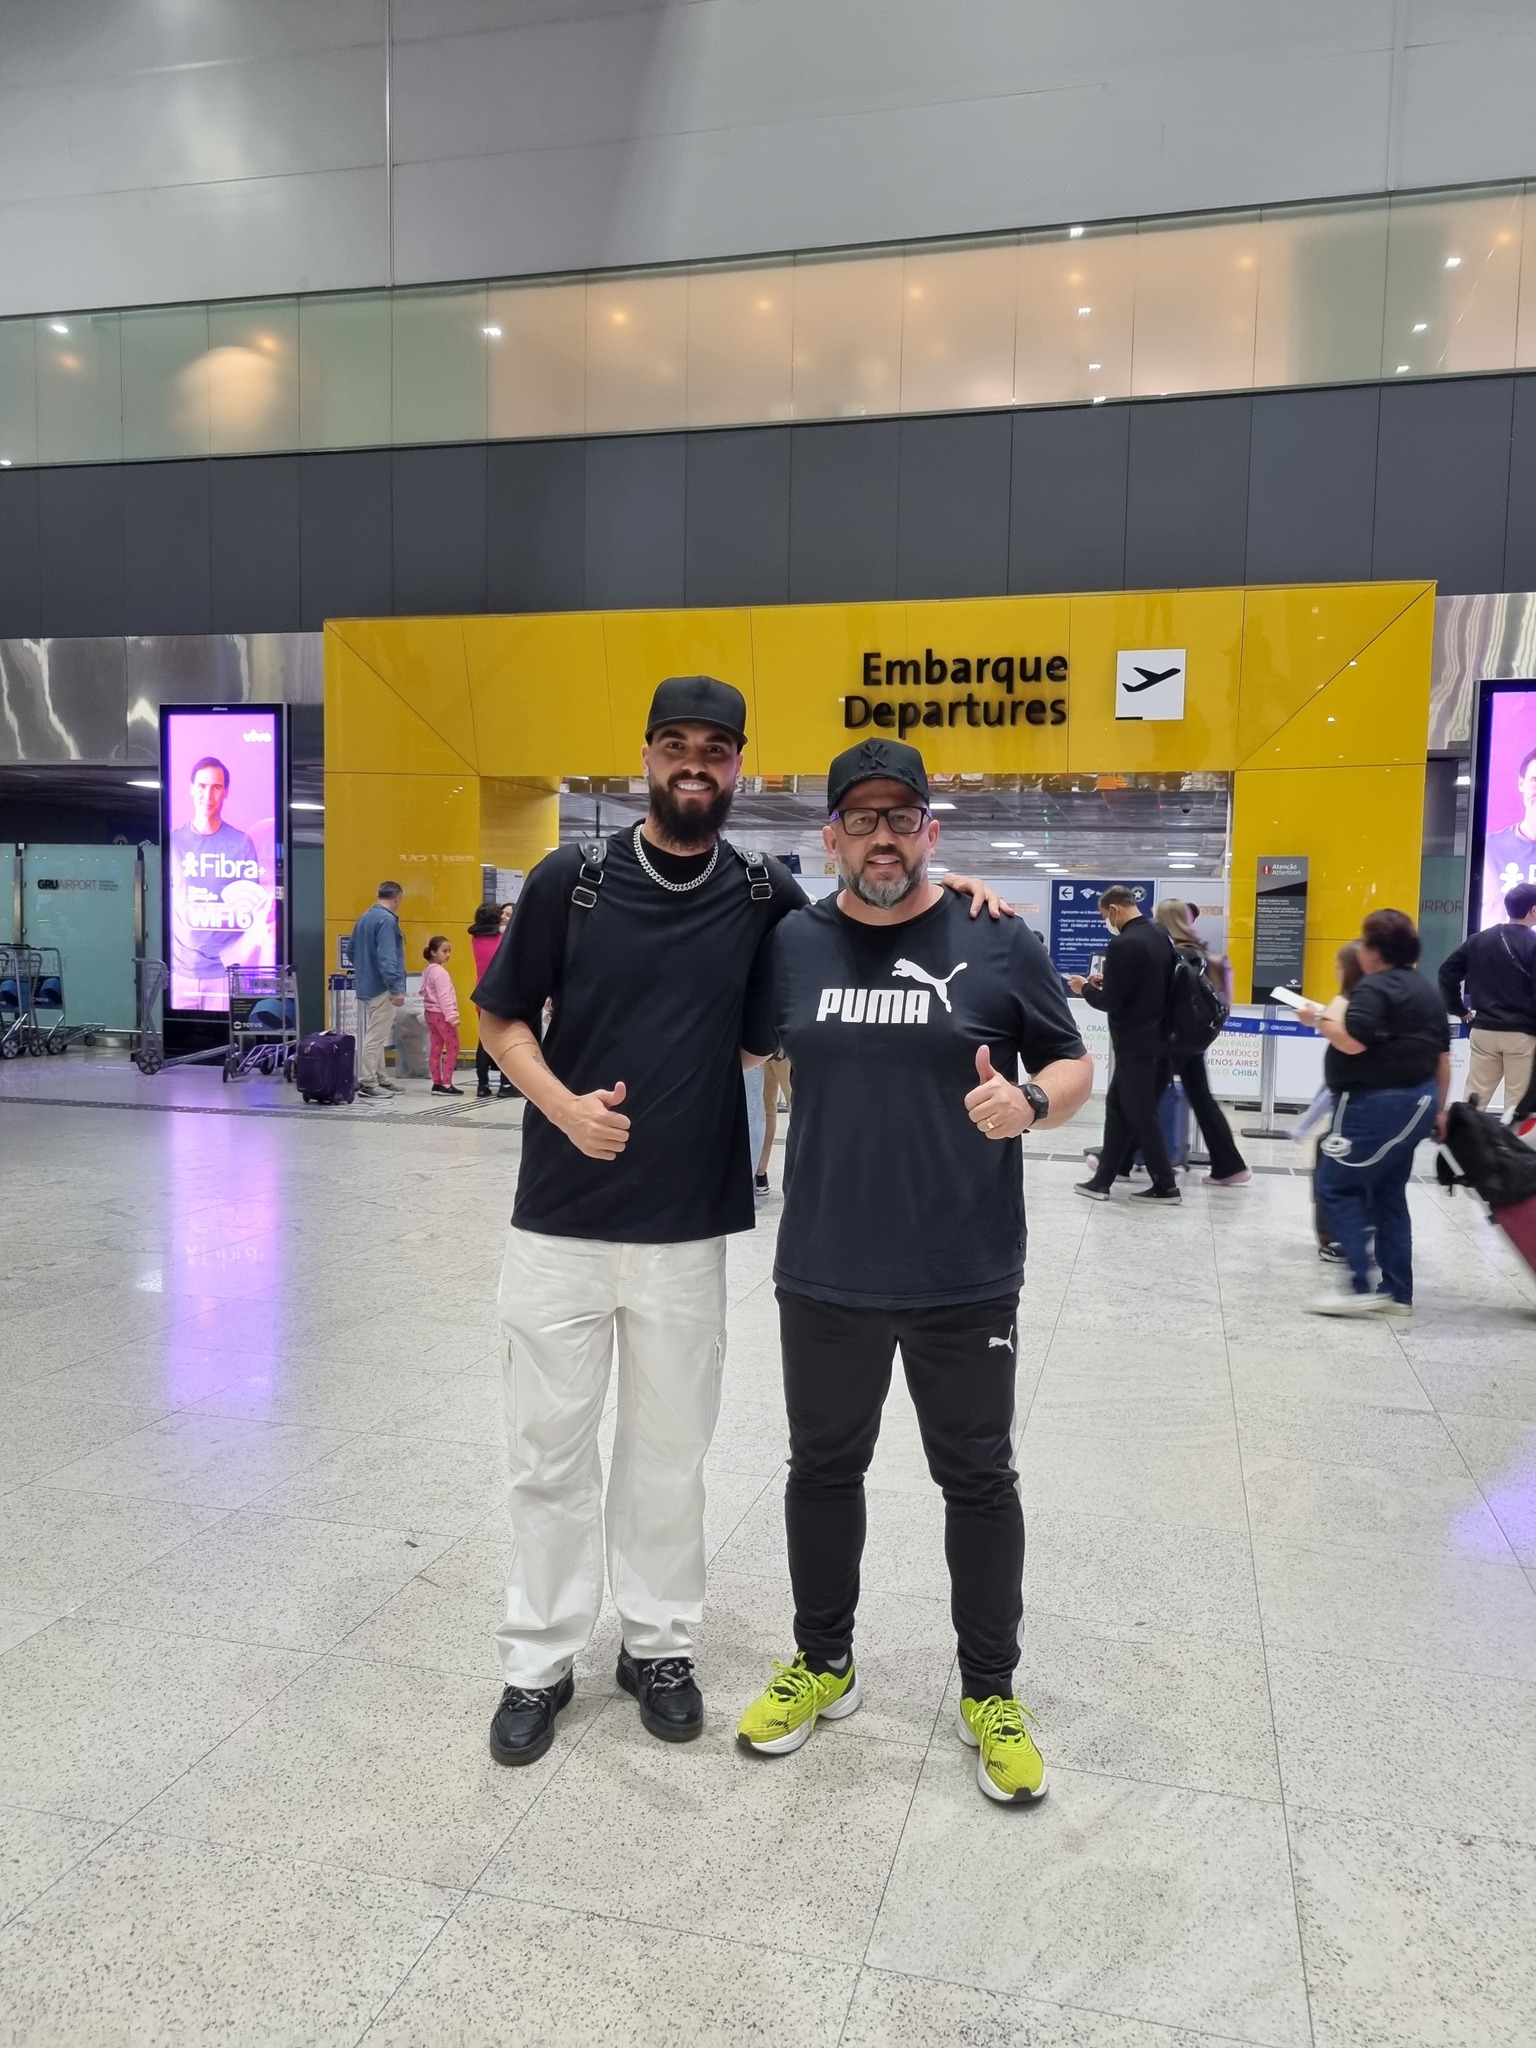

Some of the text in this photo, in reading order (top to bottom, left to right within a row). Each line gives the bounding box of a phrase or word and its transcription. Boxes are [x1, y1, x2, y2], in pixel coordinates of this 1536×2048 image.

[863, 648, 1068, 694] Embarque
[844, 693, 1067, 740] Departures
[242, 728, 272, 743] vivo
[1272, 863, 1298, 871] Atenção
[816, 989, 931, 1024] PUMA
[1087, 1024, 1108, 1032] CRAC
[1231, 1040, 1259, 1048] PAULO
[1226, 1048, 1259, 1057] MÉXICO
[1206, 1058, 1233, 1066] ENOS
